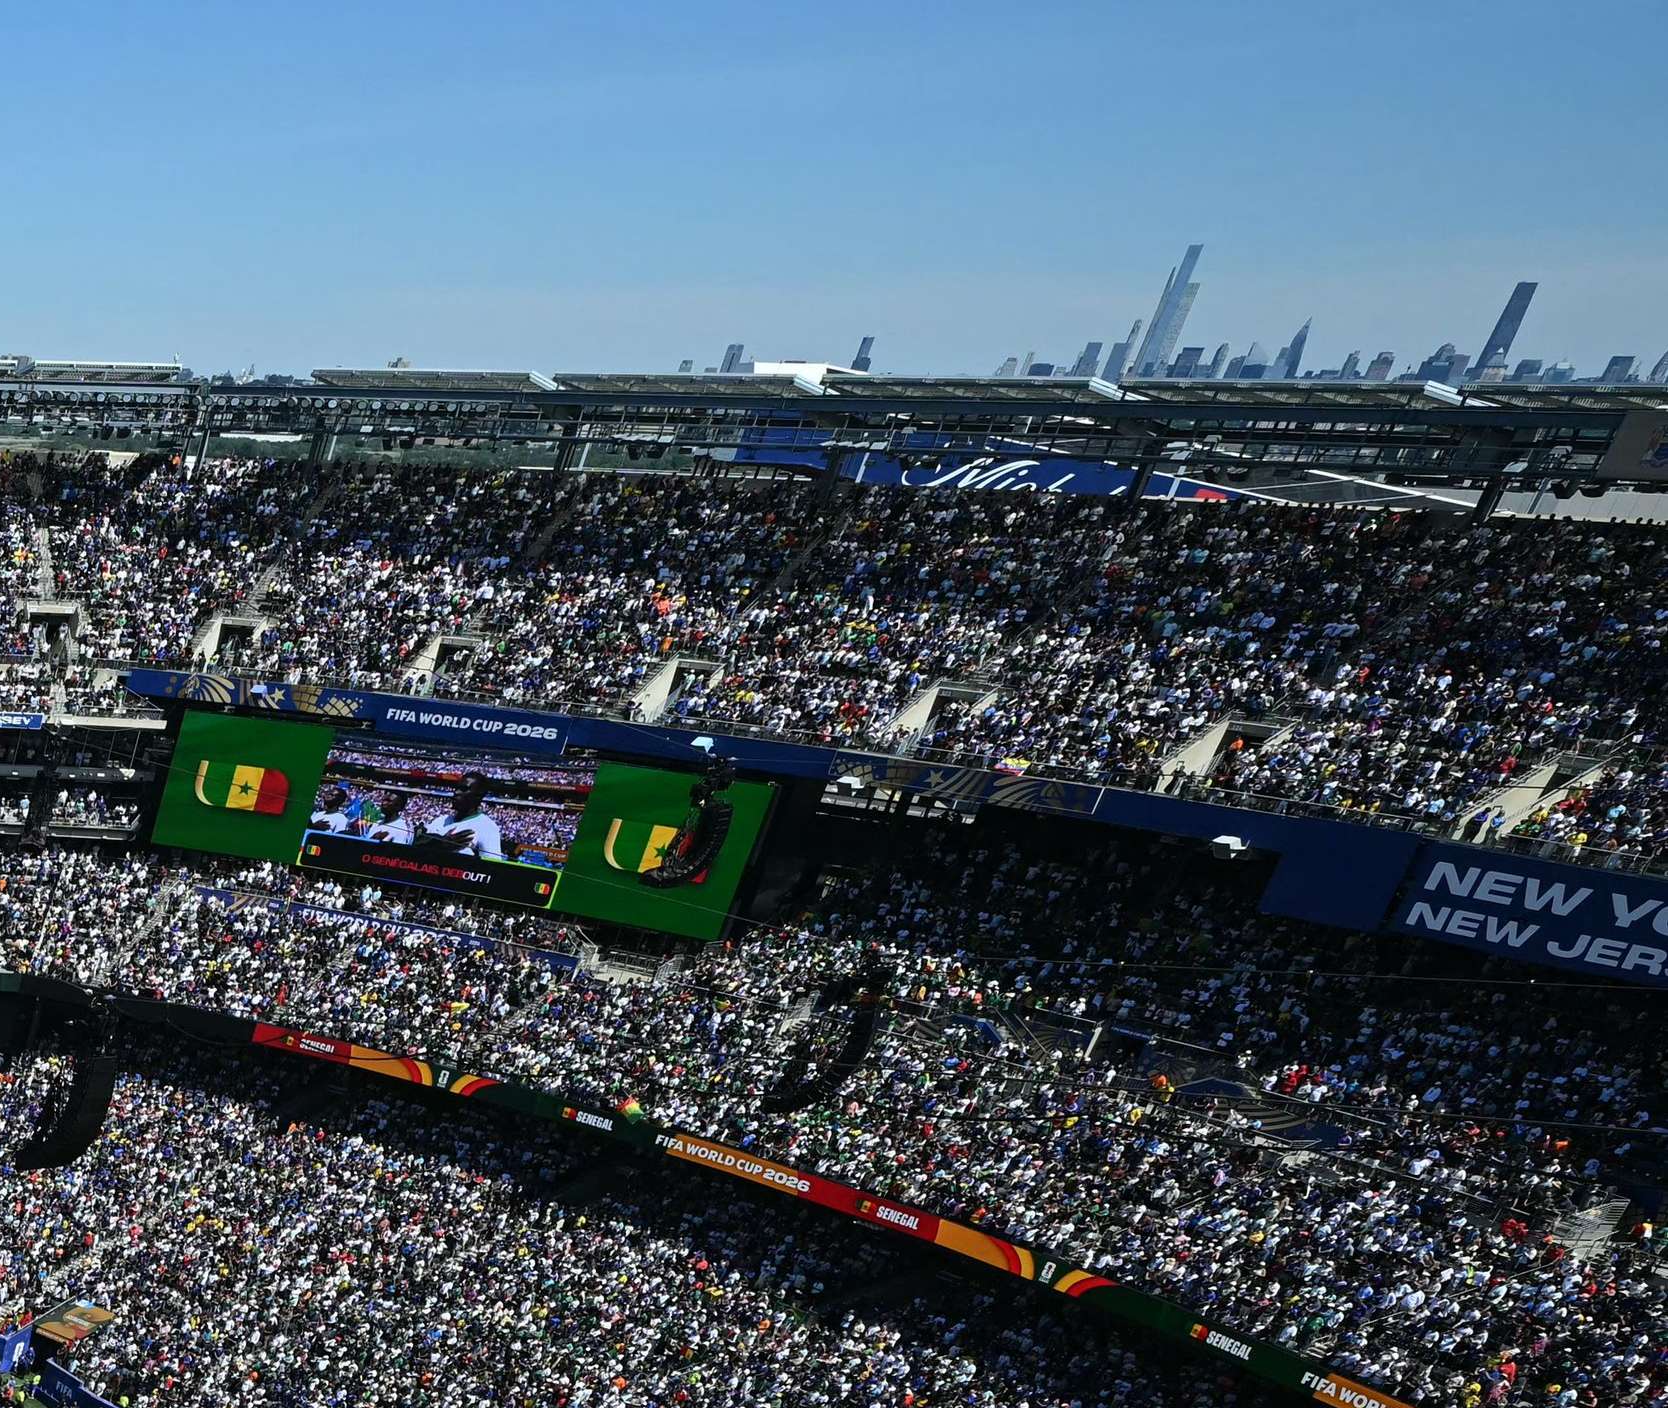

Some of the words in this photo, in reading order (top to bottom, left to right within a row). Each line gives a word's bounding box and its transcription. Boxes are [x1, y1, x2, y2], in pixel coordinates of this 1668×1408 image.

[386, 708, 415, 722] FIFA
[419, 712, 471, 729] WORLD
[472, 719, 503, 732] CUP
[504, 723, 558, 739] 2026
[1424, 861, 1593, 916] NEW
[1406, 901, 1540, 947] NEW
[576, 1111, 613, 1130] SENEGAL
[655, 1134, 683, 1152] FIFA
[686, 1143, 734, 1166] WORLD
[736, 1157, 763, 1176] CUP
[762, 1168, 811, 1192] 2026
[876, 1206, 919, 1230] SENEGAL
[1206, 1330, 1252, 1360] SENEGAL
[56, 1381, 72, 1399] FIFA
[1301, 1371, 1336, 1397] FIFA
